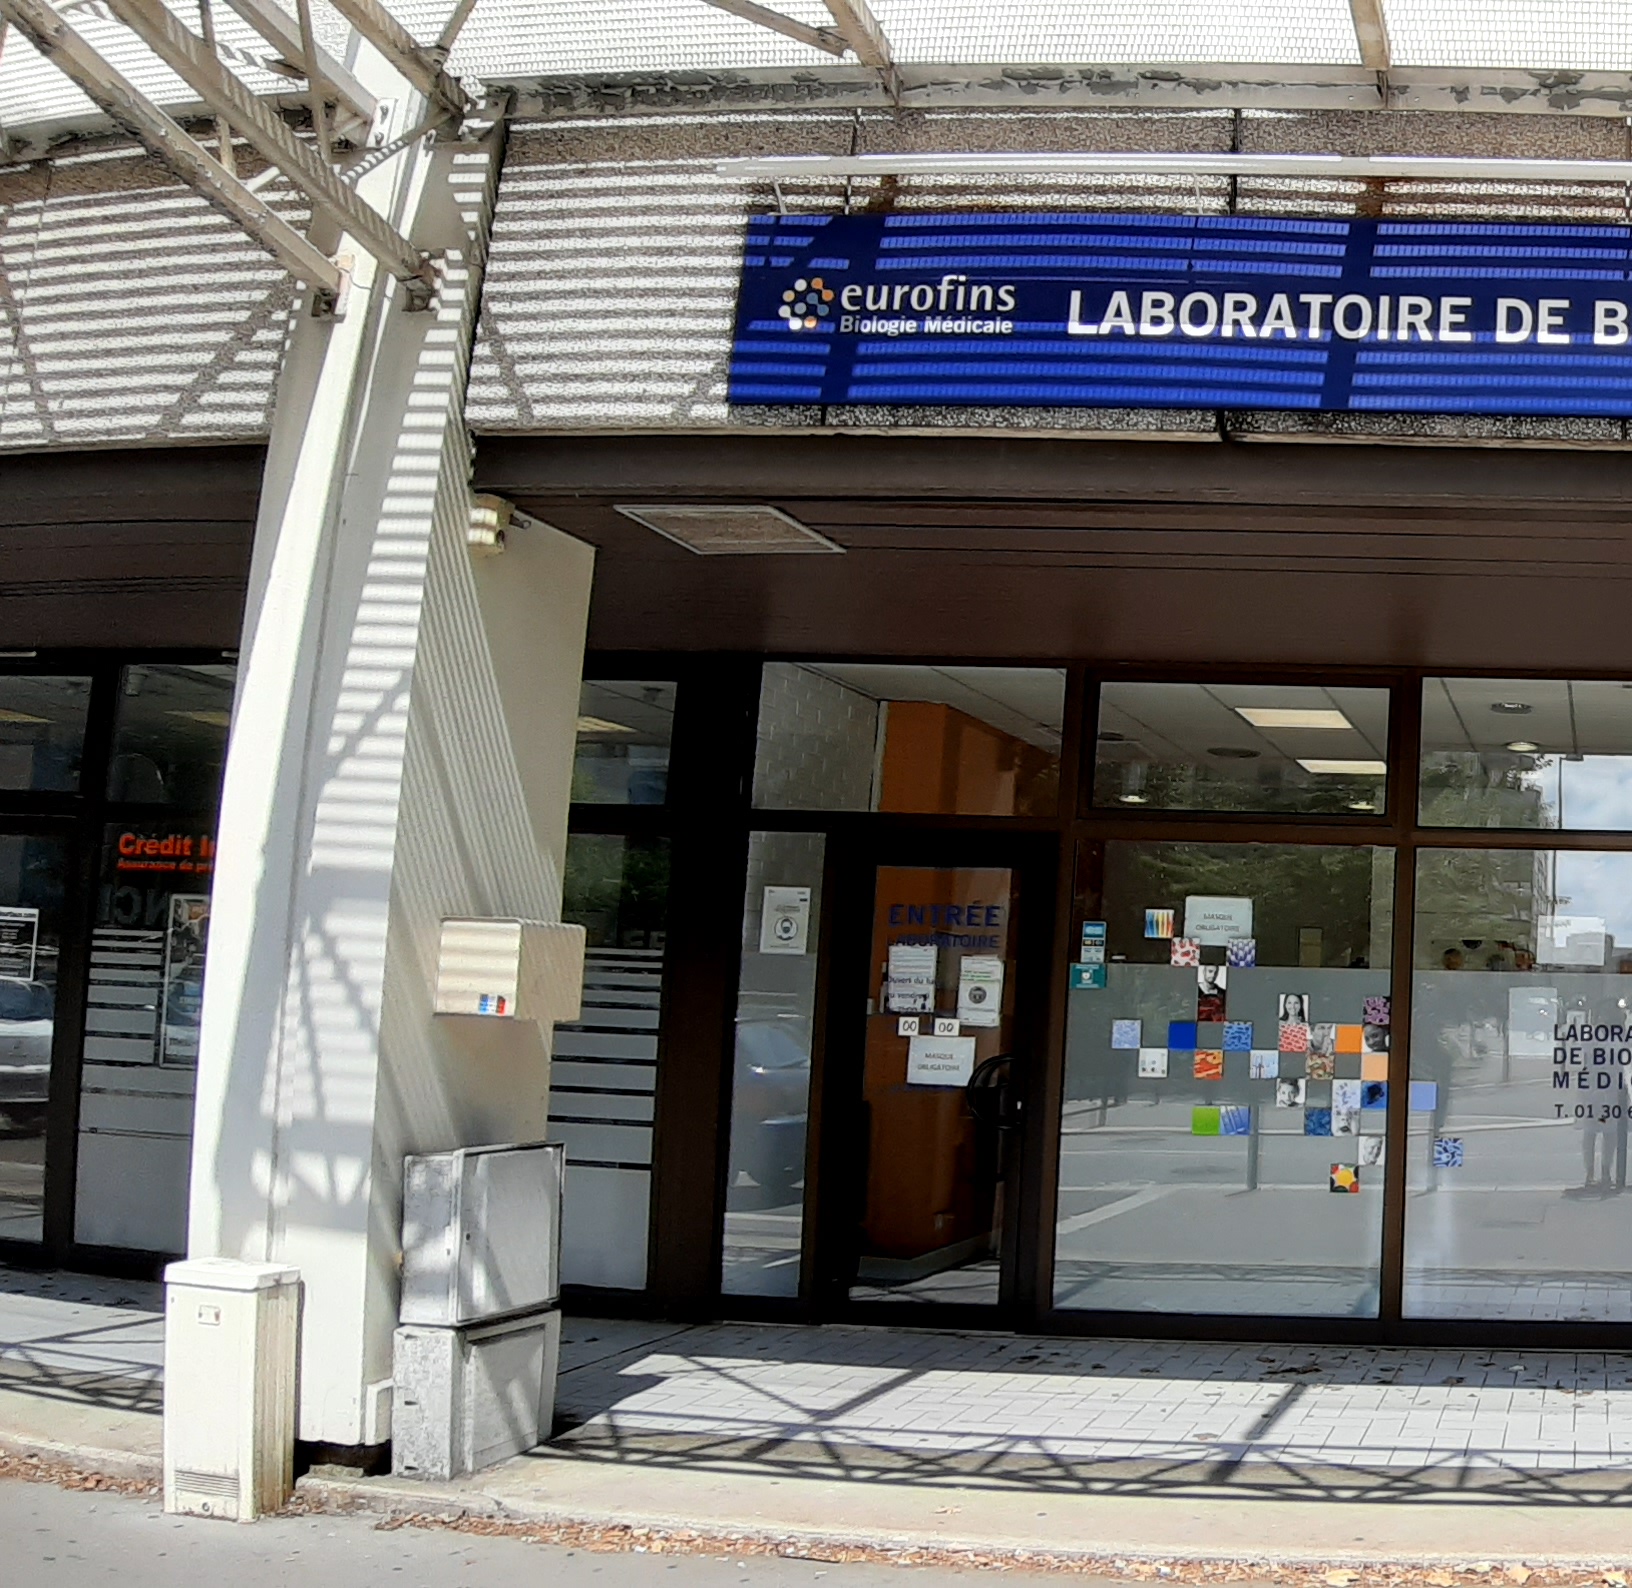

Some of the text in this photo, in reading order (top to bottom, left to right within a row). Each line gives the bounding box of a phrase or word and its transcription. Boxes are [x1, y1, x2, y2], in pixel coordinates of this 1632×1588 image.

[841, 275, 1016, 311] eurofins
[840, 315, 1013, 336] Biologie Médicale
[1067, 289, 1471, 341] LABORATOIRE
[1496, 298, 1569, 344] DE
[119, 832, 193, 857] Crédit
[888, 901, 1001, 927] ENTRÉE
[1553, 1047, 1582, 1065] DE
[1554, 1104, 1569, 1118] T.
[1575, 1104, 1594, 1118] 01
[1601, 1105, 1622, 1119] 30
